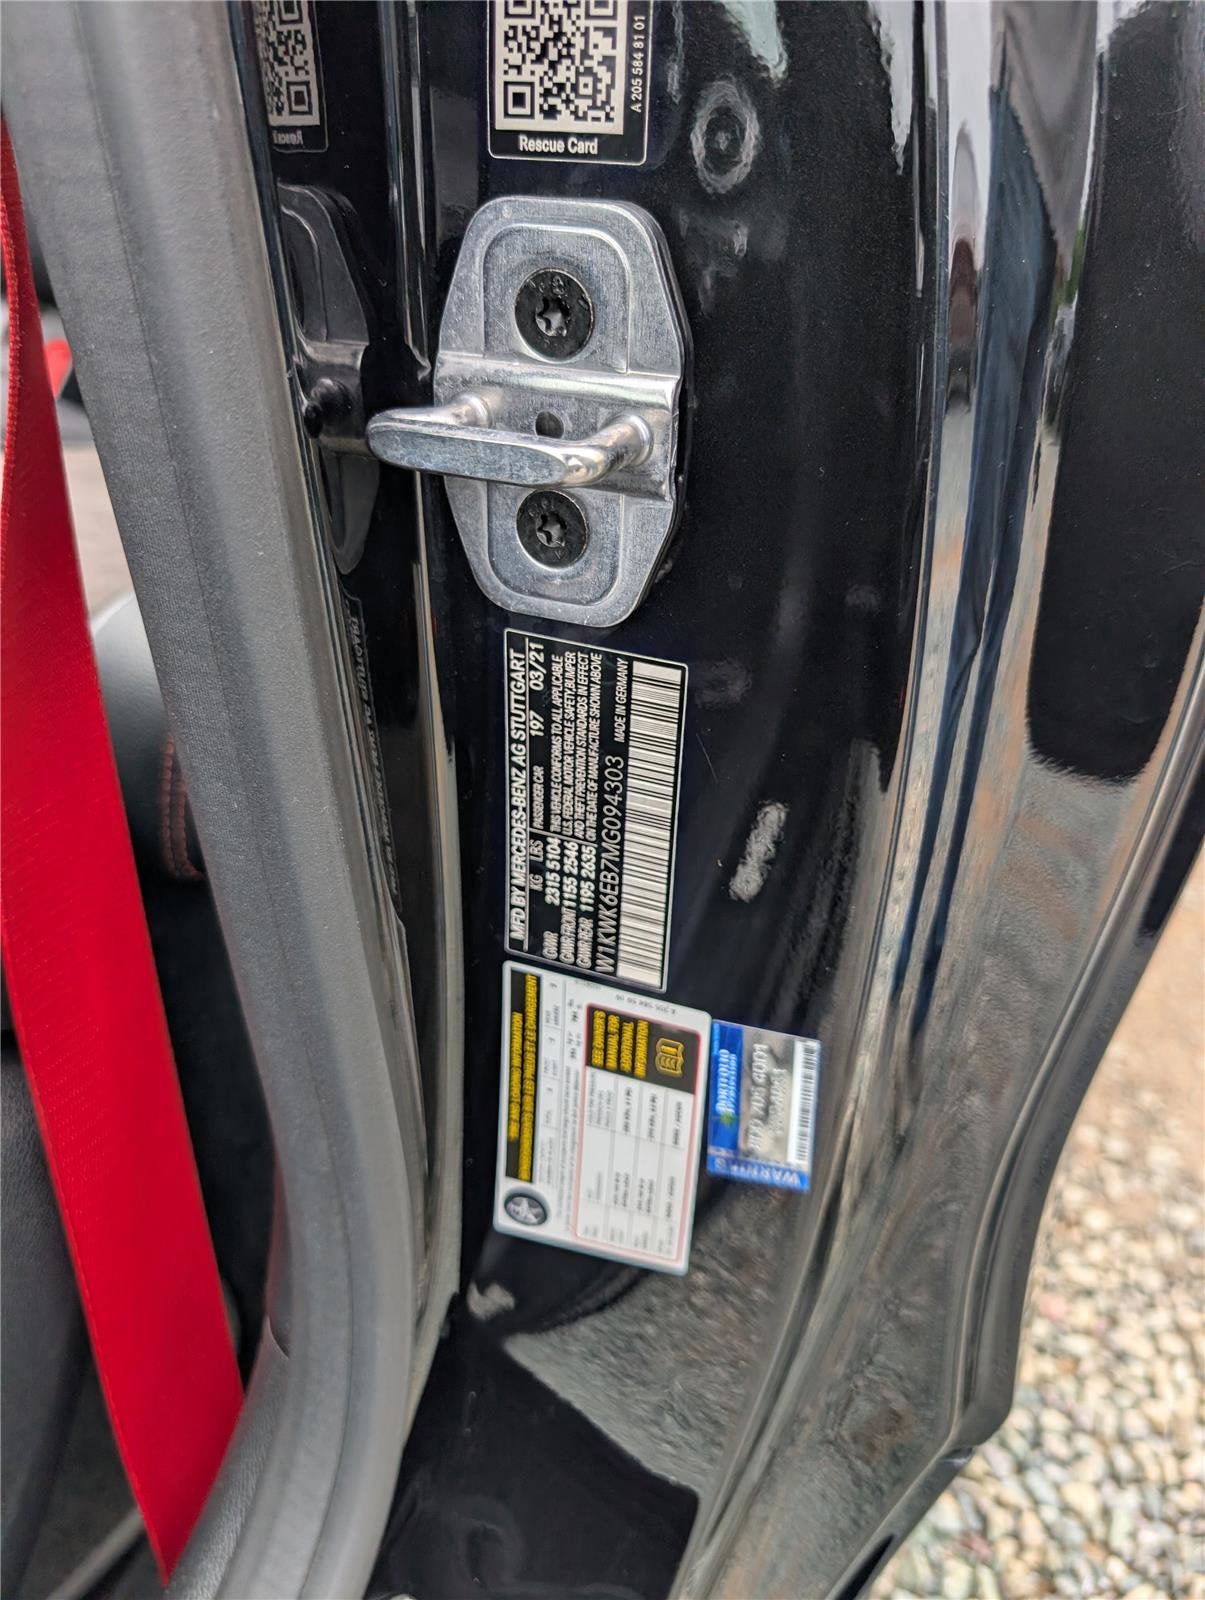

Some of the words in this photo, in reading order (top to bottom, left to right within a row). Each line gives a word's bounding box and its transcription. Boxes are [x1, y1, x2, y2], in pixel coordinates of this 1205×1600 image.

[634, 15, 646, 31] 01
[634, 35, 645, 50] 81
[633, 56, 644, 79] 584
[632, 80, 643, 100] 205
[631, 103, 642, 112] A
[518, 134, 565, 153] Rescue
[568, 136, 598, 155] Card
[530, 643, 546, 691] 03/21
[552, 654, 563, 707] APPLICABLE
[577, 652, 589, 685] EFFECT
[591, 653, 602, 684] ABOVE
[615, 658, 628, 704] GERMANY
[510, 648, 526, 741] STUTTGART
[577, 685, 588, 696] IN
[590, 684, 601, 718] SHOWN
[530, 711, 544, 737] 197
[552, 707, 563, 723] ALL
[576, 697, 587, 747] STANDARDS
[615, 704, 626, 715] IN
[551, 723, 563, 734] TO
[564, 721, 575, 754] VEHICLE
[614, 715, 626, 743] MADE
[512, 744, 526, 766] AG
[551, 736, 563, 782] CONFORMS
[588, 718, 600, 779] MANUFACTURE
[533, 766, 544, 783] CAR
[563, 754, 574, 785] MOTOR
[576, 748, 587, 797] PREVENTION
[551, 782, 562, 814] VEHICLE
[588, 780, 598, 792] OF
[532, 783, 544, 829] PASSENGER
[563, 786, 574, 820] FEDERAL
[575, 797, 586, 820] THEFT
[588, 792, 597, 813] DATE
[511, 769, 526, 886] MERCEDES-BENZ
[550, 814, 561, 832] THIS
[574, 820, 585, 840] AND
[530, 840, 543, 861] LBS
[546, 836, 561, 871] 5104
[564, 841, 579, 875] 2546
[581, 845, 597, 880] 2635
[595, 755, 624, 973] W1KWK6EB7MG094303
[511, 887, 526, 907] BY
[530, 874, 543, 891] KG
[545, 871, 560, 906] 2315
[563, 876, 577, 908] 1155
[580, 880, 595, 912] 1195
[511, 908, 526, 940] MFD
[526, 974, 539, 1029] CHARGEMENT
[510, 1011, 523, 1067] INFORMATION
[592, 1010, 606, 1048] OWNER'S
[608, 1015, 620, 1033] FOR
[591, 1048, 604, 1067] SEE
[606, 1034, 618, 1070] MANUAL
[620, 1022, 634, 1072] ADDITIONAL
[633, 1020, 649, 1079] INFORMATION
[523, 1051, 536, 1080] PNEUS
[510, 1066, 522, 1103] LOADING
